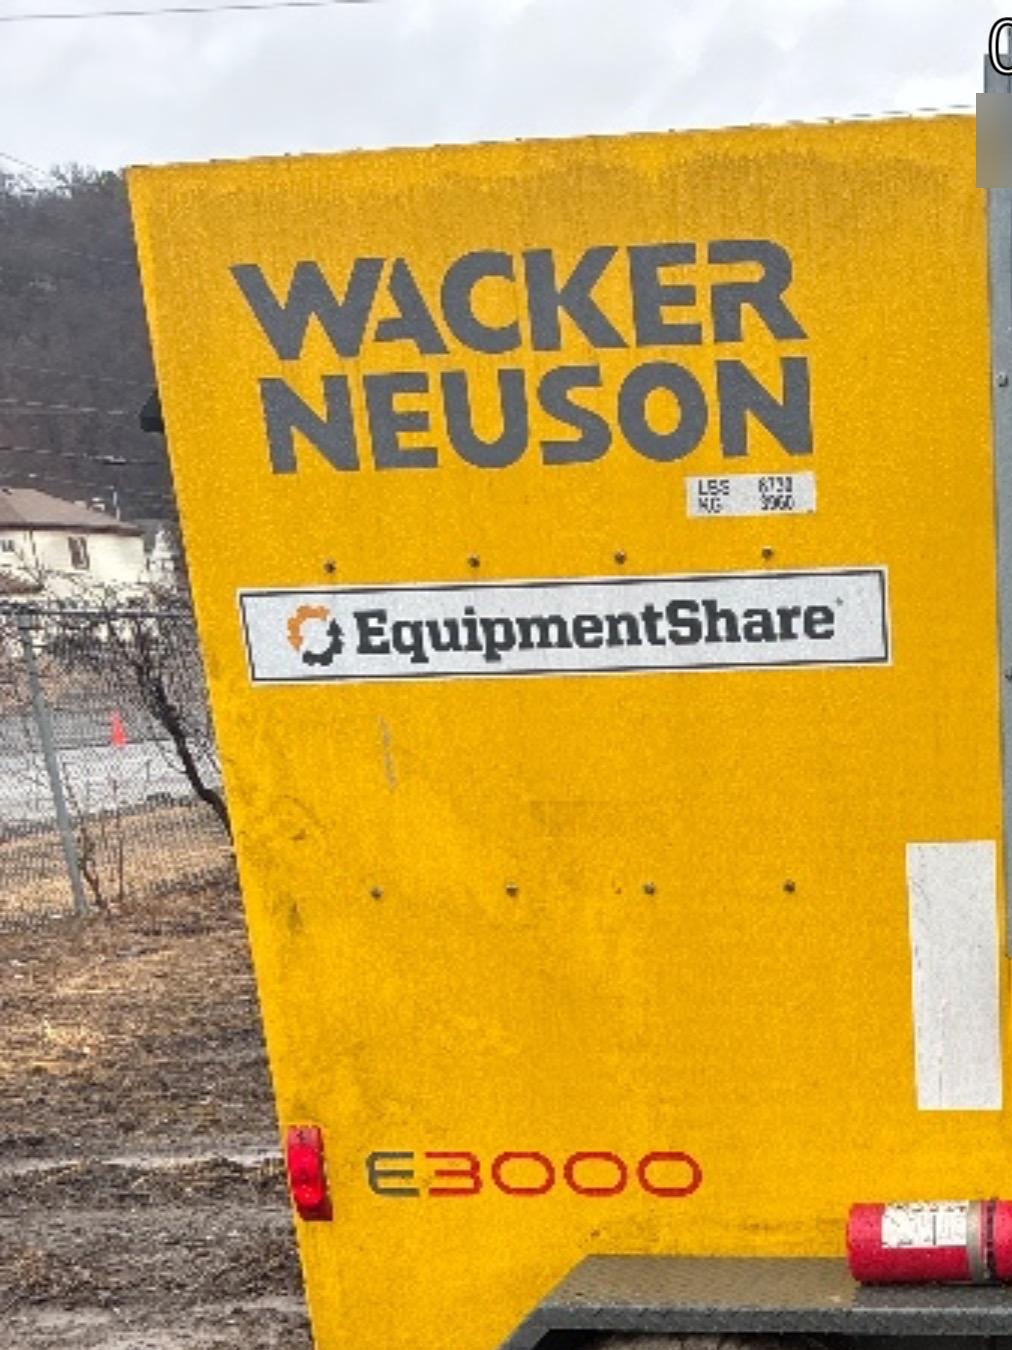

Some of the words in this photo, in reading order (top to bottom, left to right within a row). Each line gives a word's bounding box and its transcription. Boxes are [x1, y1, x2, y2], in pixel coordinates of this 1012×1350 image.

[229, 239, 809, 361] WACKER
[258, 356, 814, 475] NEUSON
[698, 479, 730, 496] LBS
[698, 497, 722, 513] KG
[353, 598, 836, 663] EquipmentShare
[365, 1151, 703, 1197] E3000
